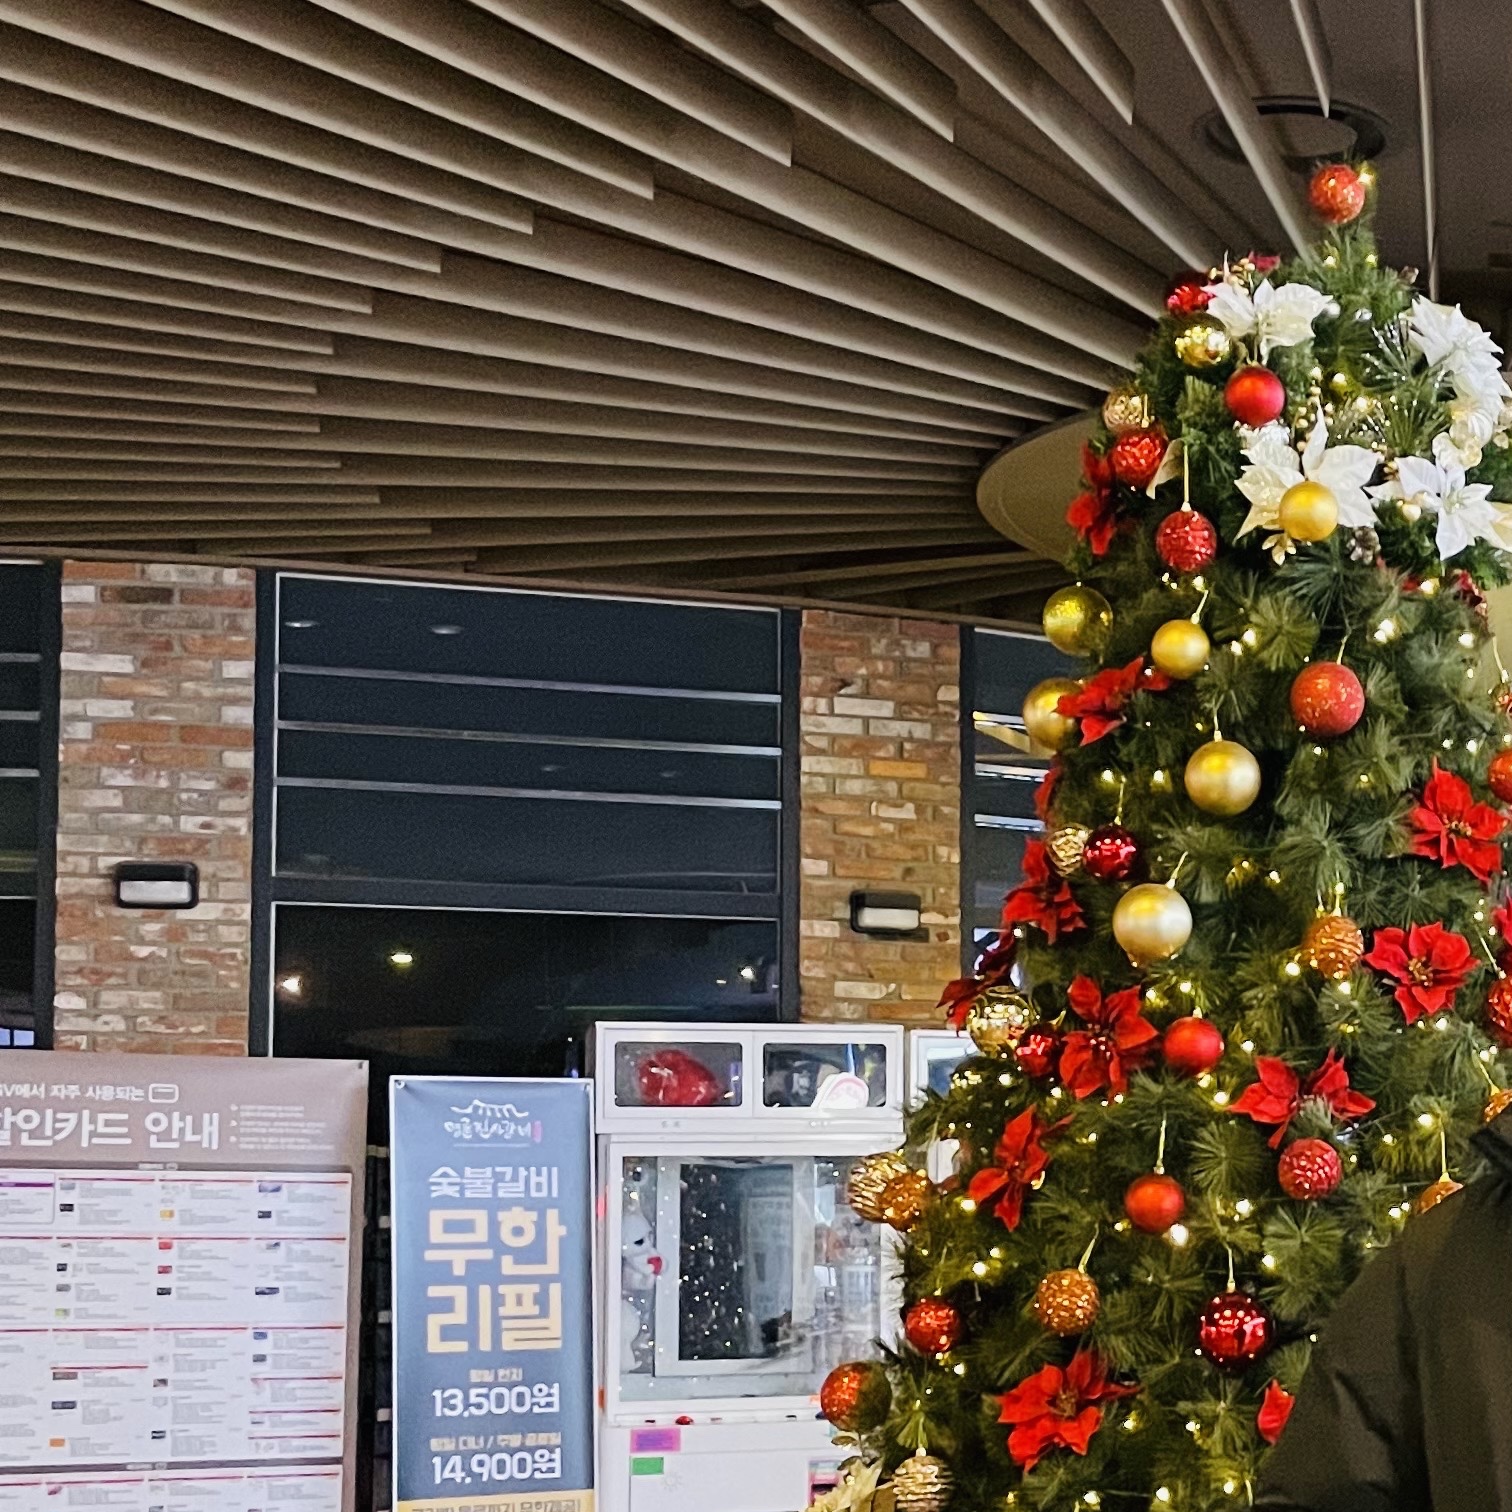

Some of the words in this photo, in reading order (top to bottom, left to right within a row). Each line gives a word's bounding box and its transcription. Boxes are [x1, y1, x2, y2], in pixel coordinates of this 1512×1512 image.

[51, 1084, 81, 1100] 자주
[86, 1085, 145, 1101] 사용되는
[144, 1111, 220, 1150] 안내
[428, 1166, 559, 1198] 숯불갈비
[424, 1206, 567, 1276] 무한
[427, 1283, 562, 1352] 리필
